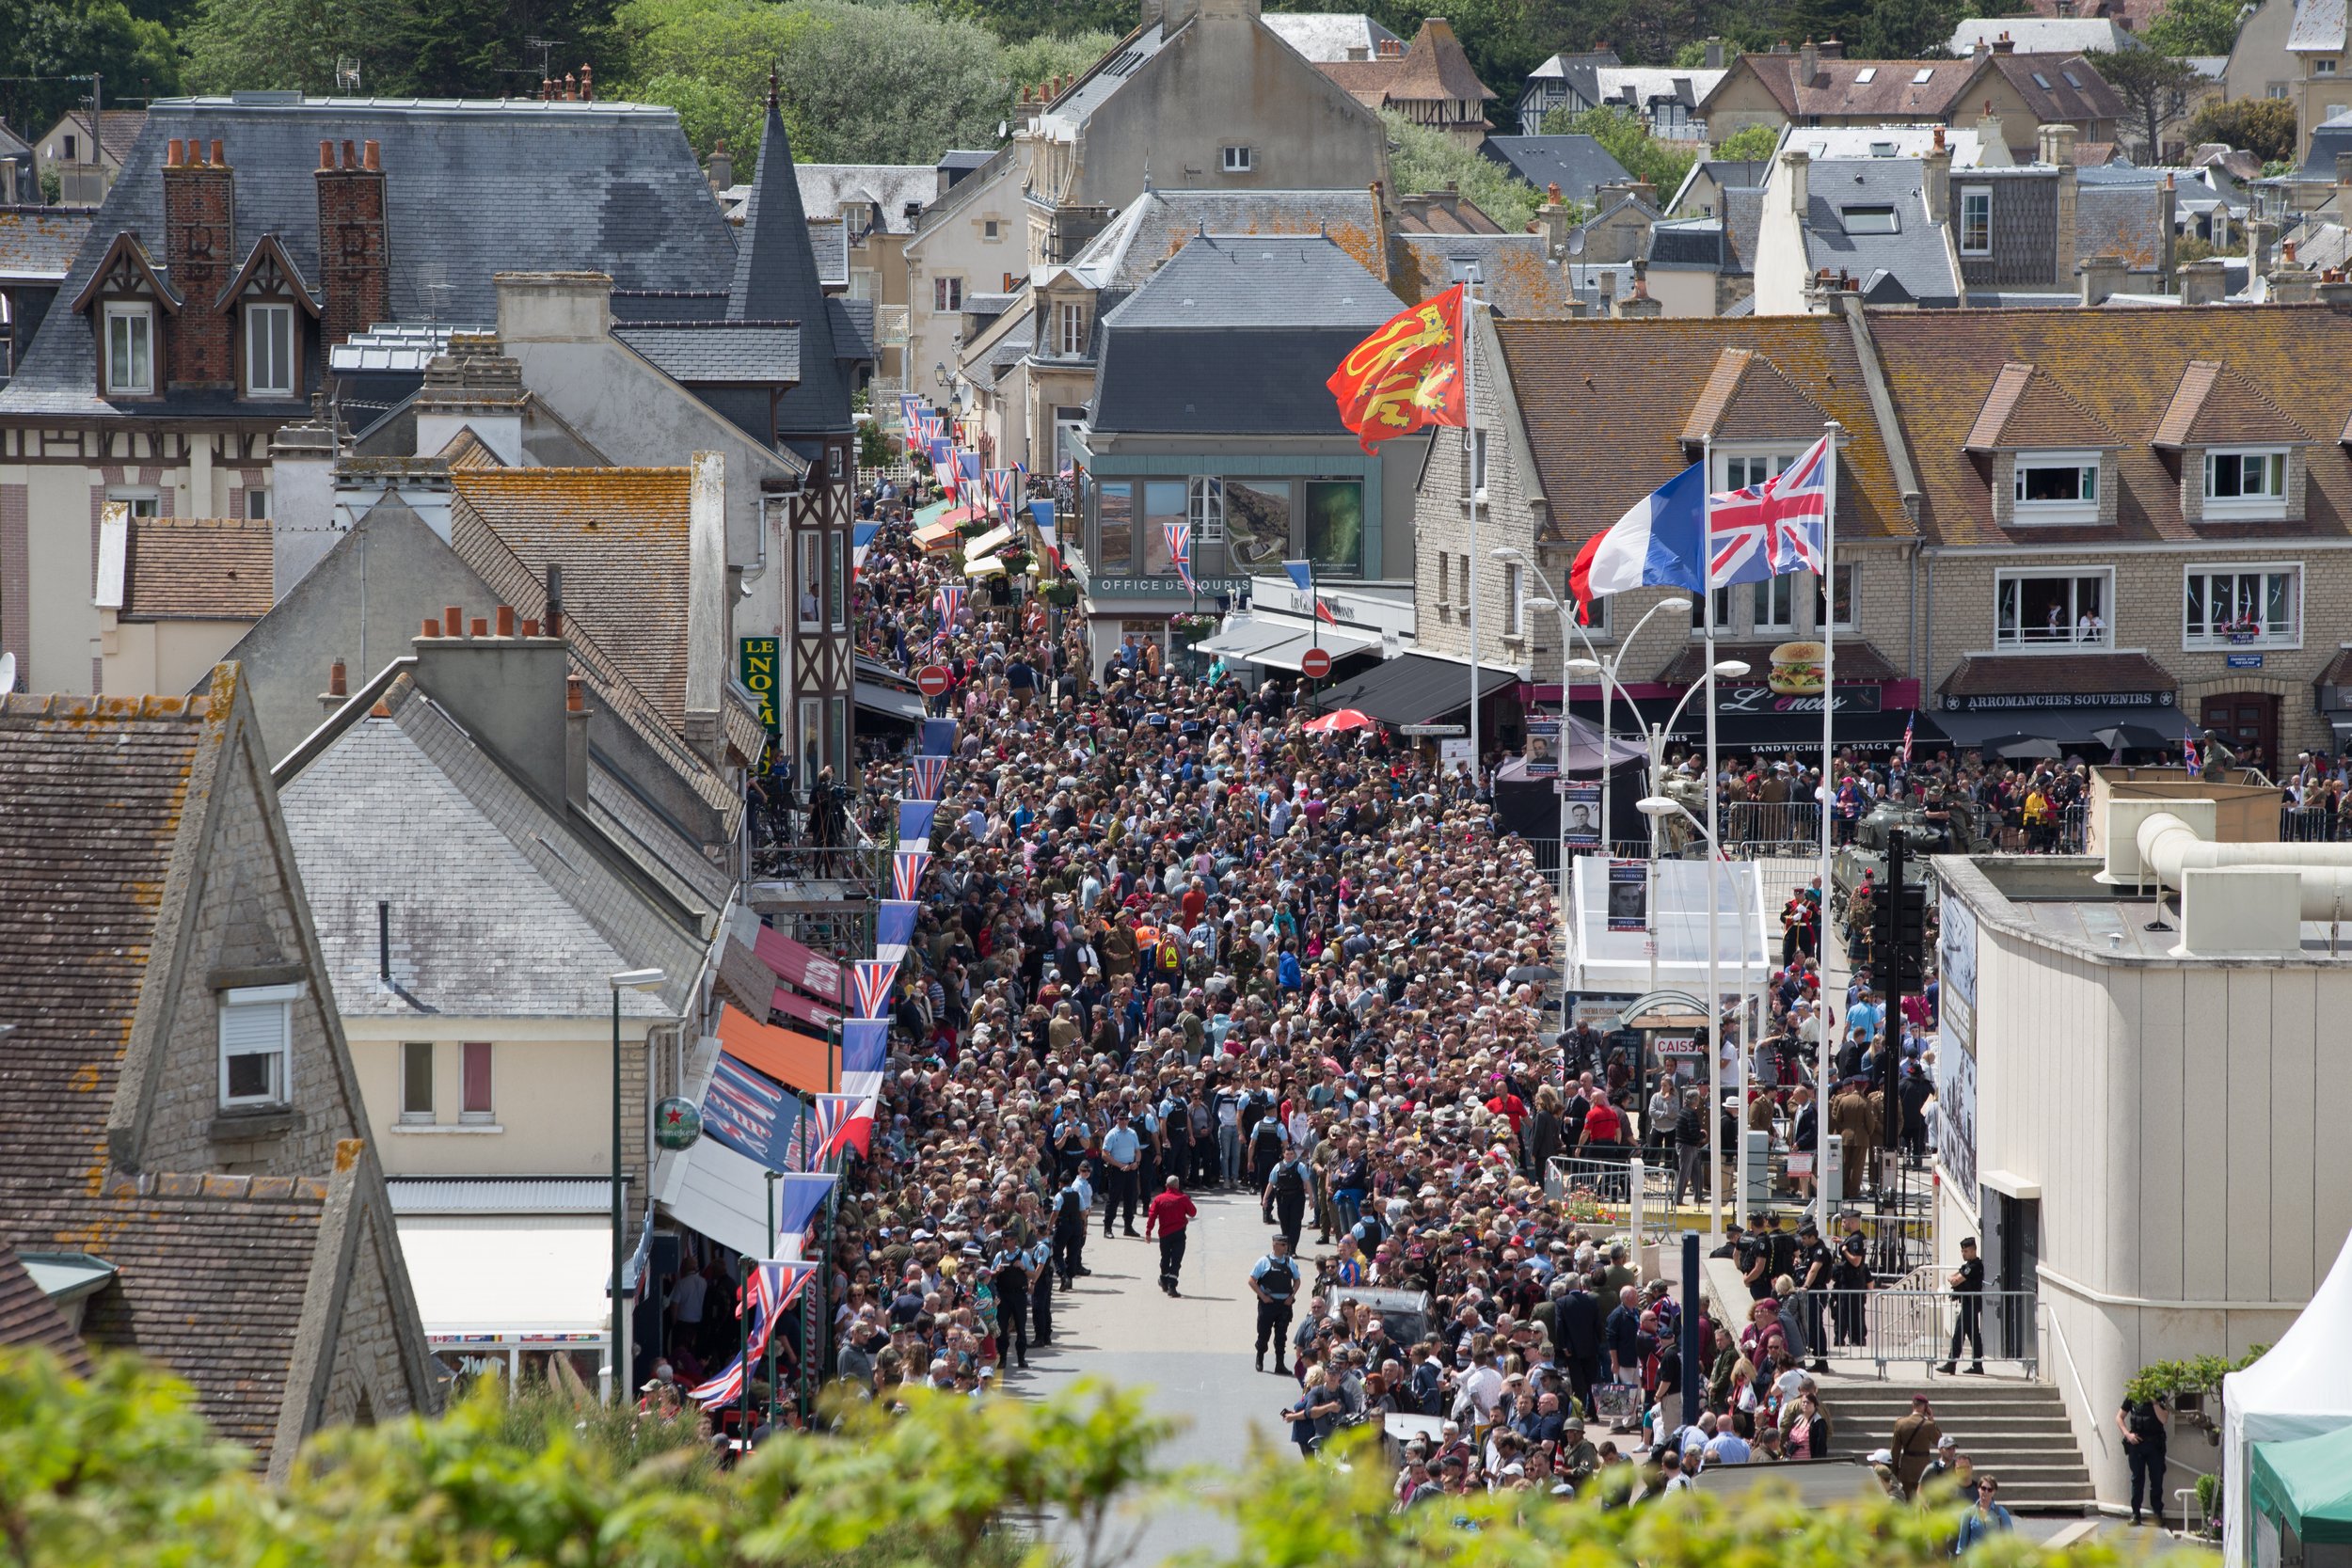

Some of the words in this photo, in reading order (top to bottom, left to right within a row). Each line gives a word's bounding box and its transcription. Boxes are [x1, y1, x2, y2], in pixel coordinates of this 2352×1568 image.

[1101, 579, 1159, 591] OFFICE
[1165, 580, 1184, 591] DE
[1200, 579, 1250, 591] OURIS
[745, 641, 774, 653] LE
[1967, 694, 2072, 708] ARROMANCHES
[2074, 692, 2153, 706] SOUVENIRS
[1750, 743, 1839, 753] SANDWICHERE
[1851, 742, 1891, 752] SNACK
[1658, 1040, 1705, 1053] CAISS
